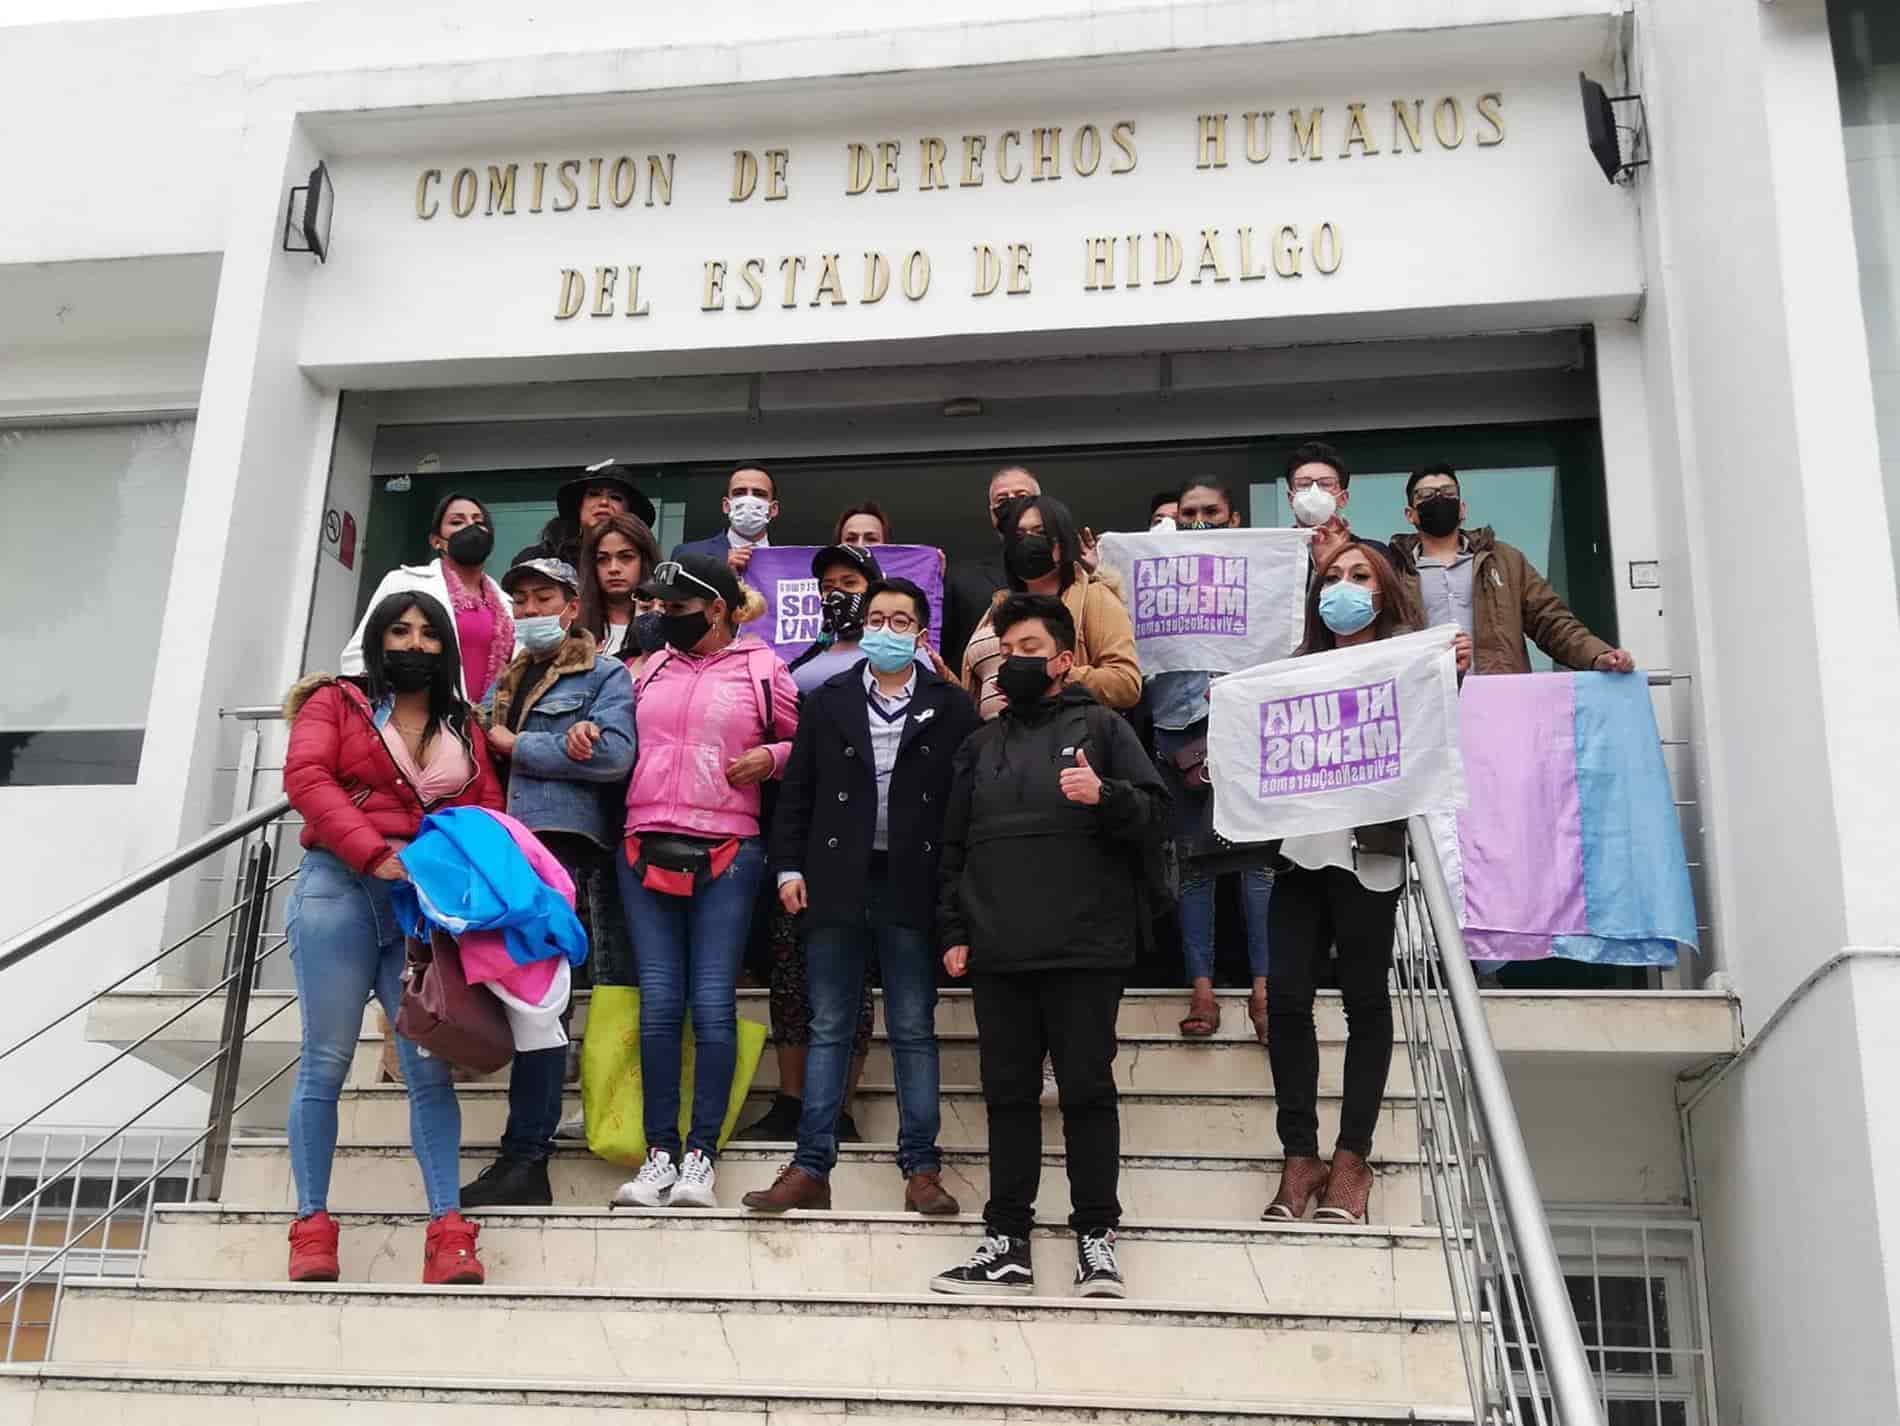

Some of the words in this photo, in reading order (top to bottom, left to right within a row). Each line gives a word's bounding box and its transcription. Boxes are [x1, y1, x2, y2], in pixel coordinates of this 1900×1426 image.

[415, 152, 677, 220] COMISION
[729, 149, 790, 203] DE
[845, 120, 1138, 195] DERECHOS
[1195, 91, 1505, 169] HUMANOS
[553, 264, 651, 321] DEL
[700, 247, 932, 312] ESTADO
[971, 240, 1033, 298] DE
[1083, 221, 1344, 291] HIDALGO
